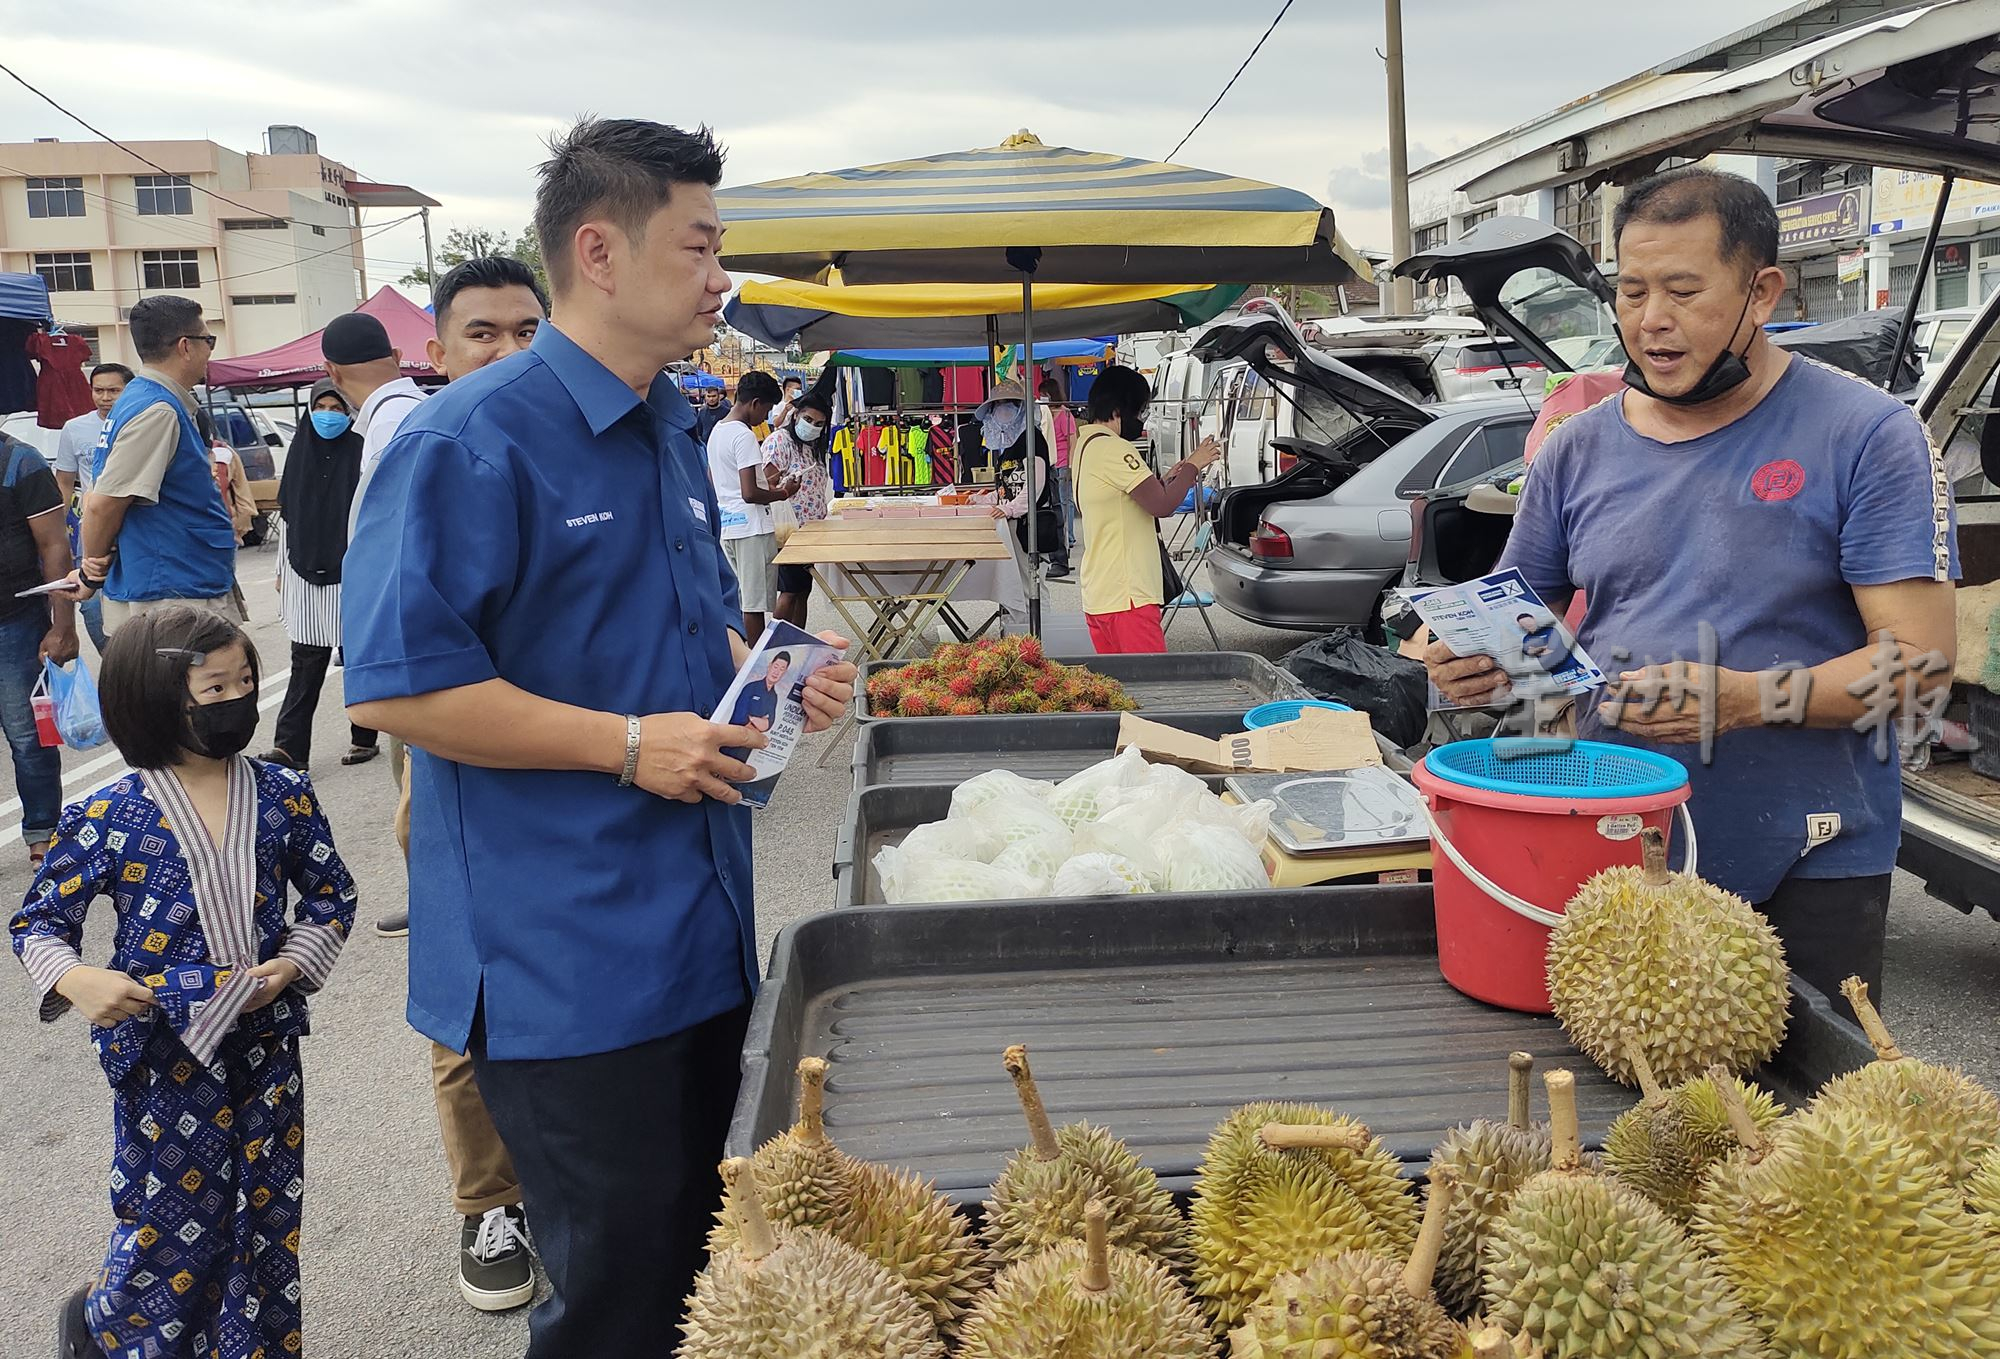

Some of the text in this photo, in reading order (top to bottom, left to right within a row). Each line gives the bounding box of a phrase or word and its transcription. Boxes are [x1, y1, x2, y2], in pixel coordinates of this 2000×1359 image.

[1898, 170, 1909, 184] LEE
[566, 511, 615, 528] STEVEN KOH
[1431, 609, 1475, 621] STEVEN KOH
